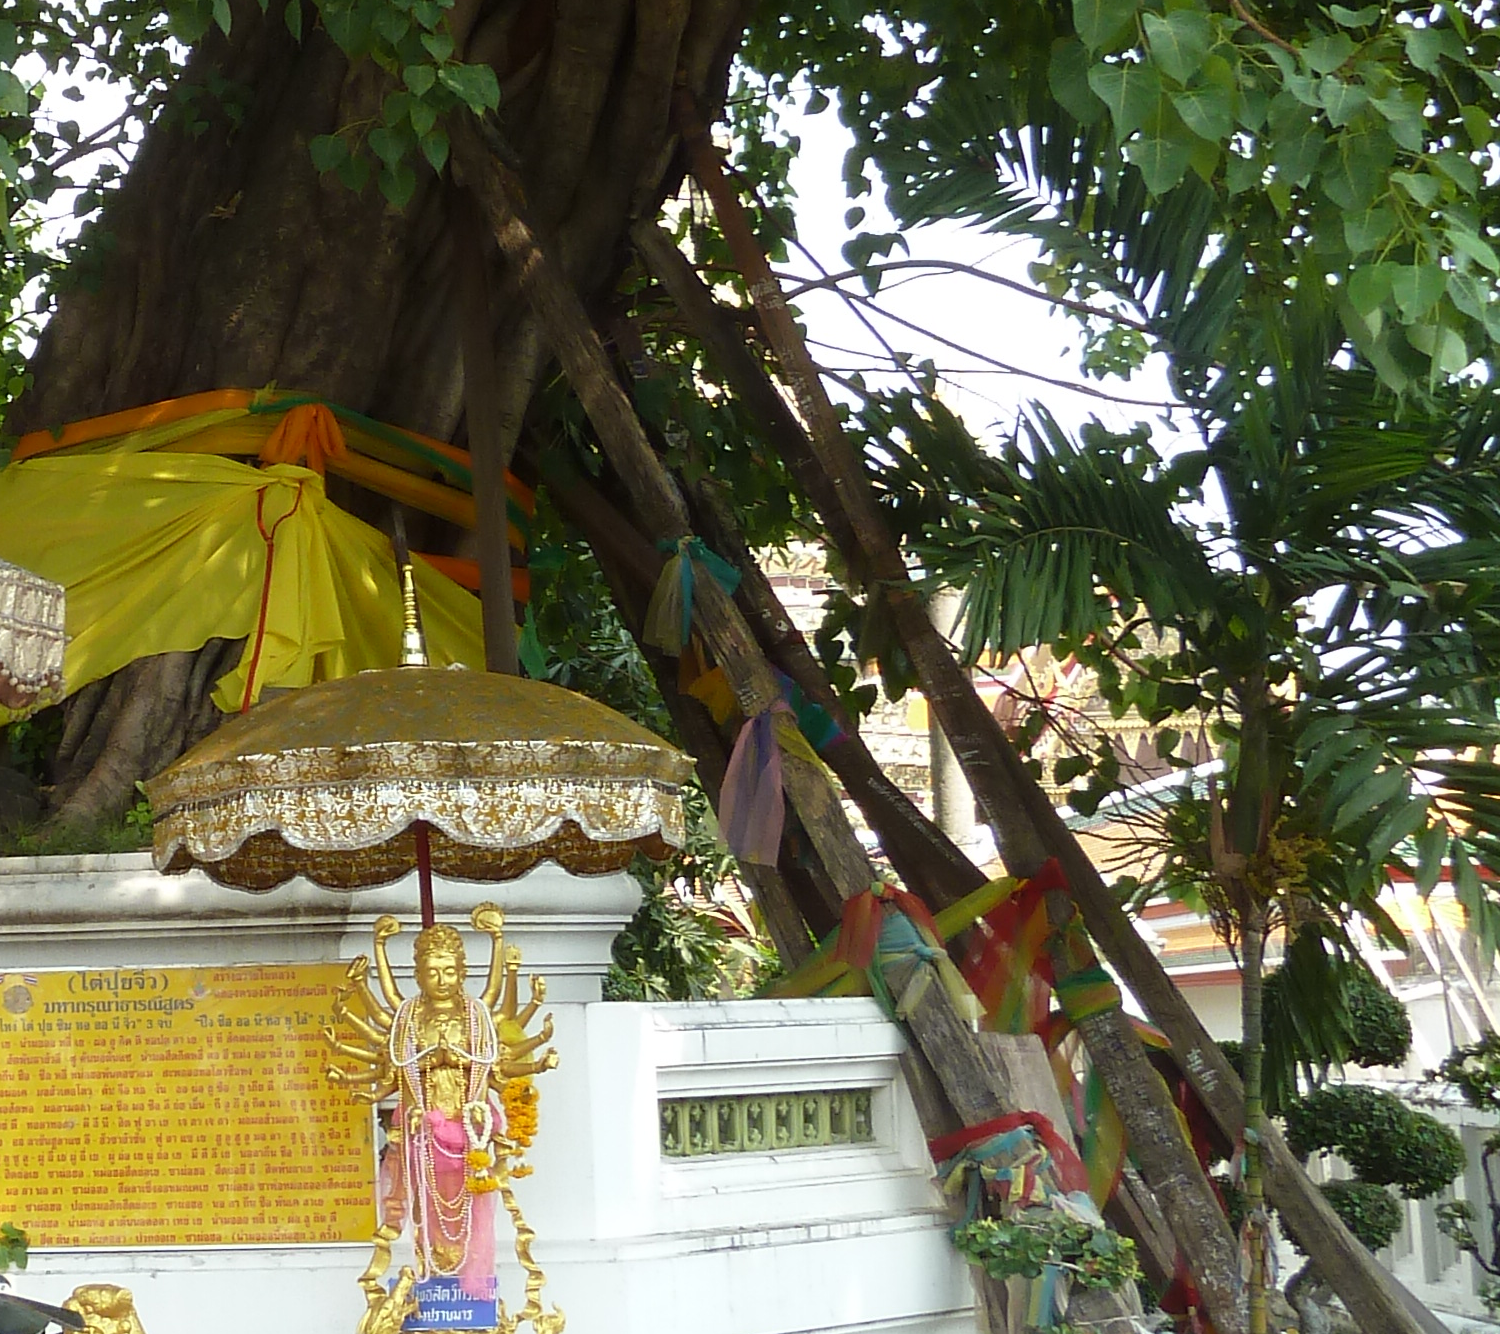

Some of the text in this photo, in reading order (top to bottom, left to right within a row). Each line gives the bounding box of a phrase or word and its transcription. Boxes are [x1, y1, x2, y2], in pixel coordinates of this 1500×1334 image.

[44, 996, 195, 1017] มหากรุณาธารณีสูตร
